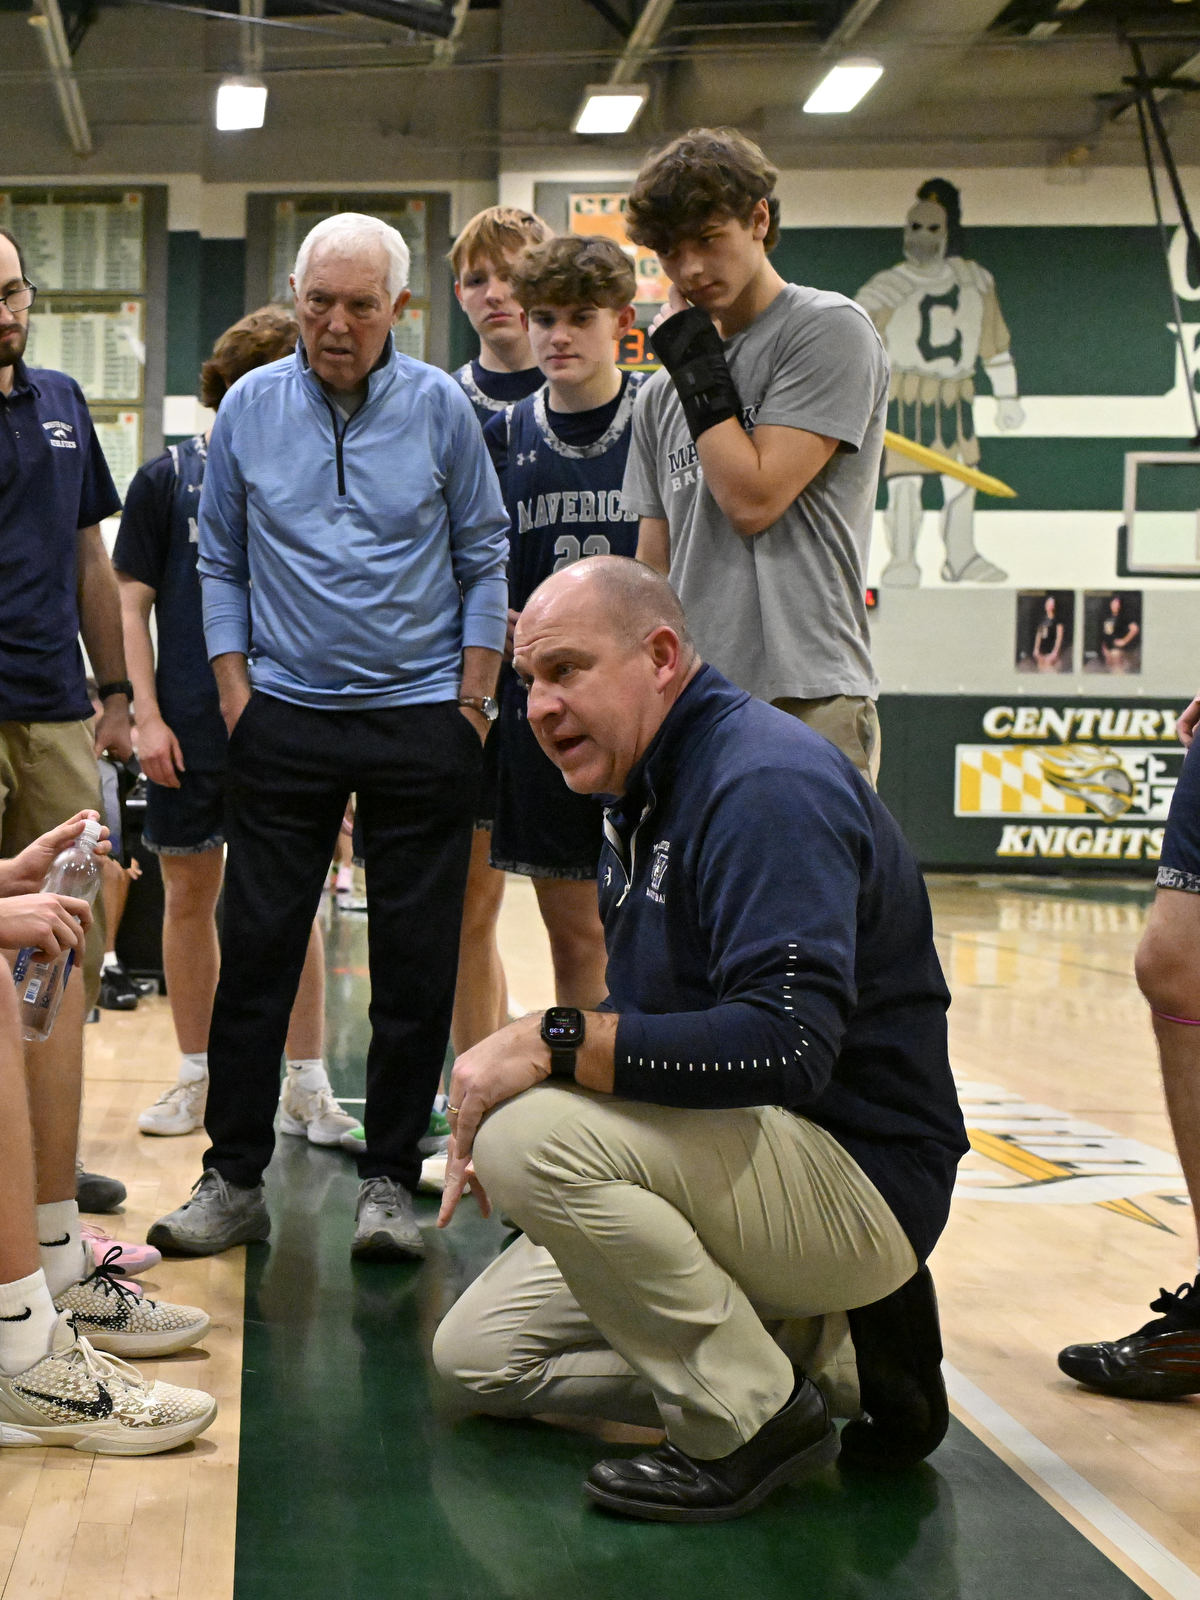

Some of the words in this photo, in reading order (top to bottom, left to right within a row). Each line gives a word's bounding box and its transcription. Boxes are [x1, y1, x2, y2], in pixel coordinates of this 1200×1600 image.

[917, 283, 963, 367] C
[982, 705, 1179, 745] CENTURY
[995, 824, 1166, 860] KNIGHTS
